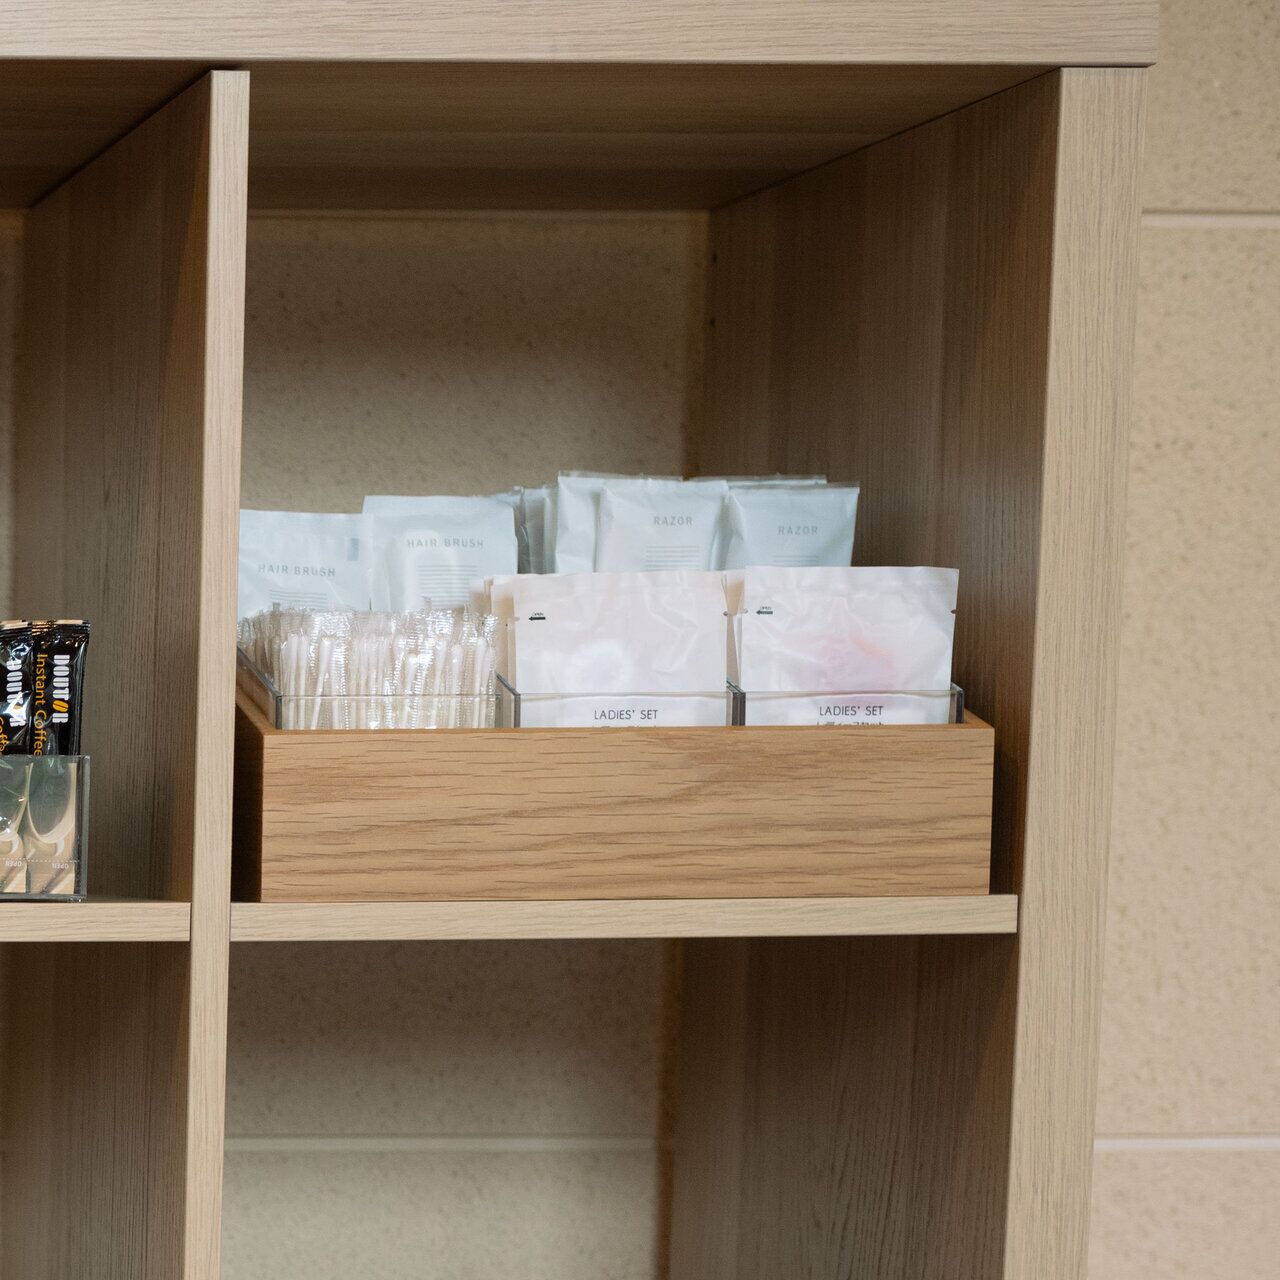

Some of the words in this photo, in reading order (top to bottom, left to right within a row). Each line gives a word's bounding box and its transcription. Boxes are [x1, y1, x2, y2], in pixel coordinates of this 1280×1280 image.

[653, 516, 693, 527] RAZOR
[777, 525, 819, 536] RAZOR
[406, 538, 438, 549] HAIR
[444, 537, 484, 549] BRUSH
[258, 564, 288, 574] HAIR
[294, 565, 336, 577] BRUSH
[35, 654, 48, 706] Instant
[52, 654, 71, 723] DOUTOR
[594, 709, 636, 721] LADIES'
[640, 709, 658, 721] SET
[819, 705, 861, 717] LADIES'
[865, 706, 883, 717] SET
[34, 710, 47, 756] Coffee
